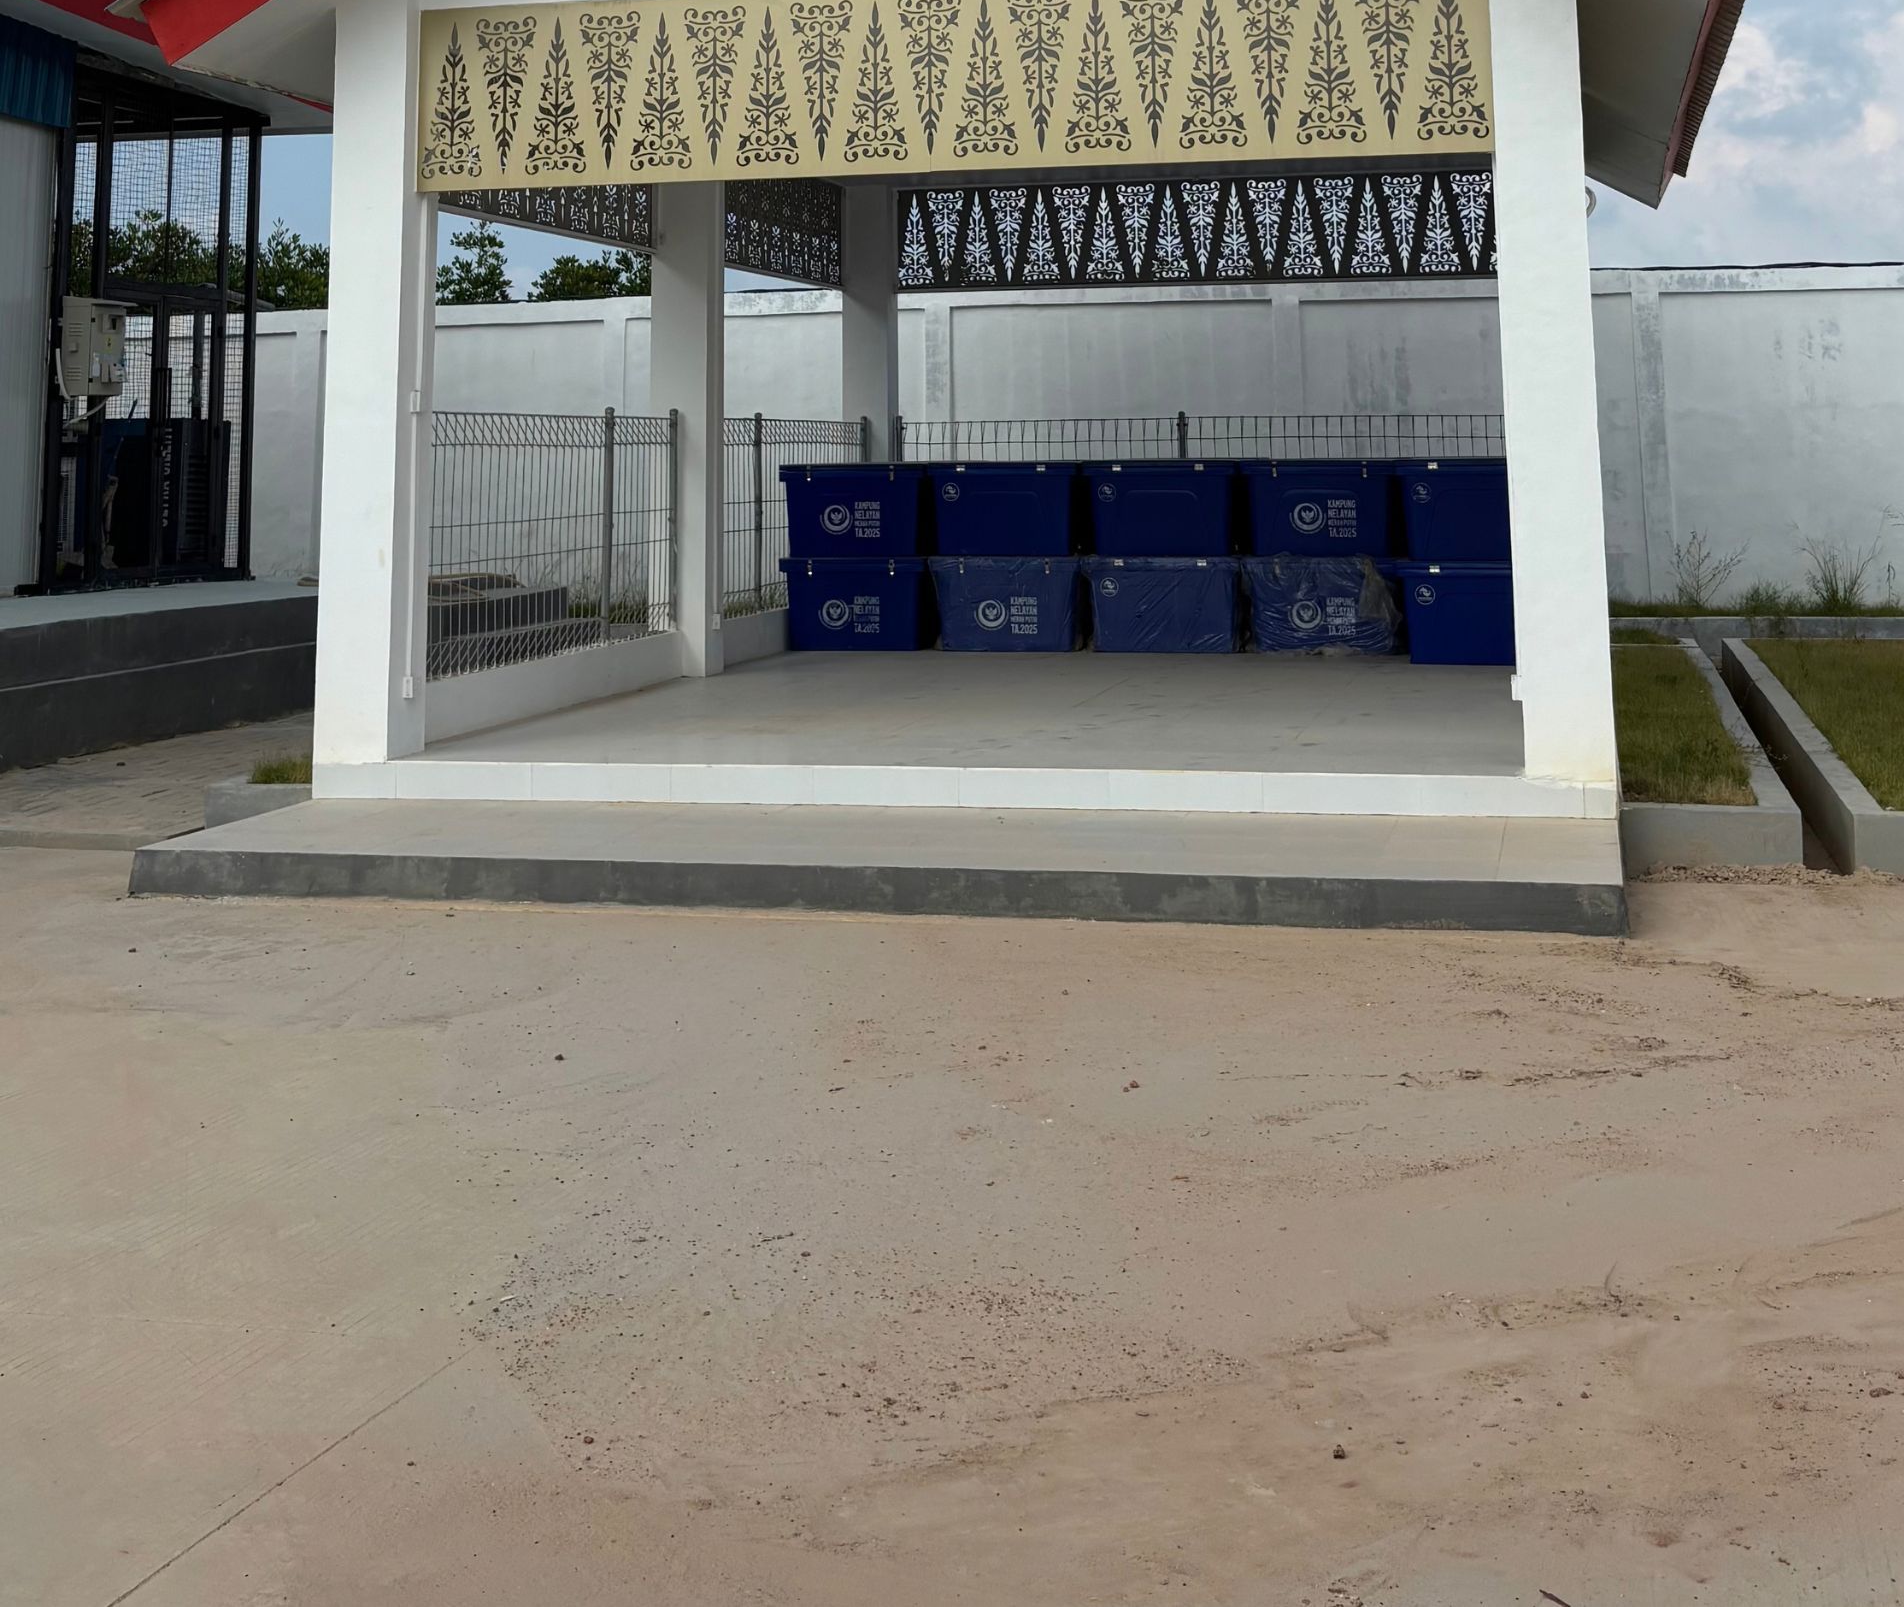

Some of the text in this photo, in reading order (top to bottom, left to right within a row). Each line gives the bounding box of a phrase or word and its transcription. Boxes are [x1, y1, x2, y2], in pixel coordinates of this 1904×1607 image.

[1328, 499, 1356, 508] KAMPUNG
[854, 510, 880, 519] NELAYAN
[1328, 509, 1356, 518] NELAYAN
[855, 528, 880, 538] TA.2025
[1328, 527, 1357, 538] TA.2025
[1010, 596, 1037, 604] KAMPUNG
[1010, 606, 1037, 614] NELAYAN
[1010, 624, 1038, 634] TA.2025
